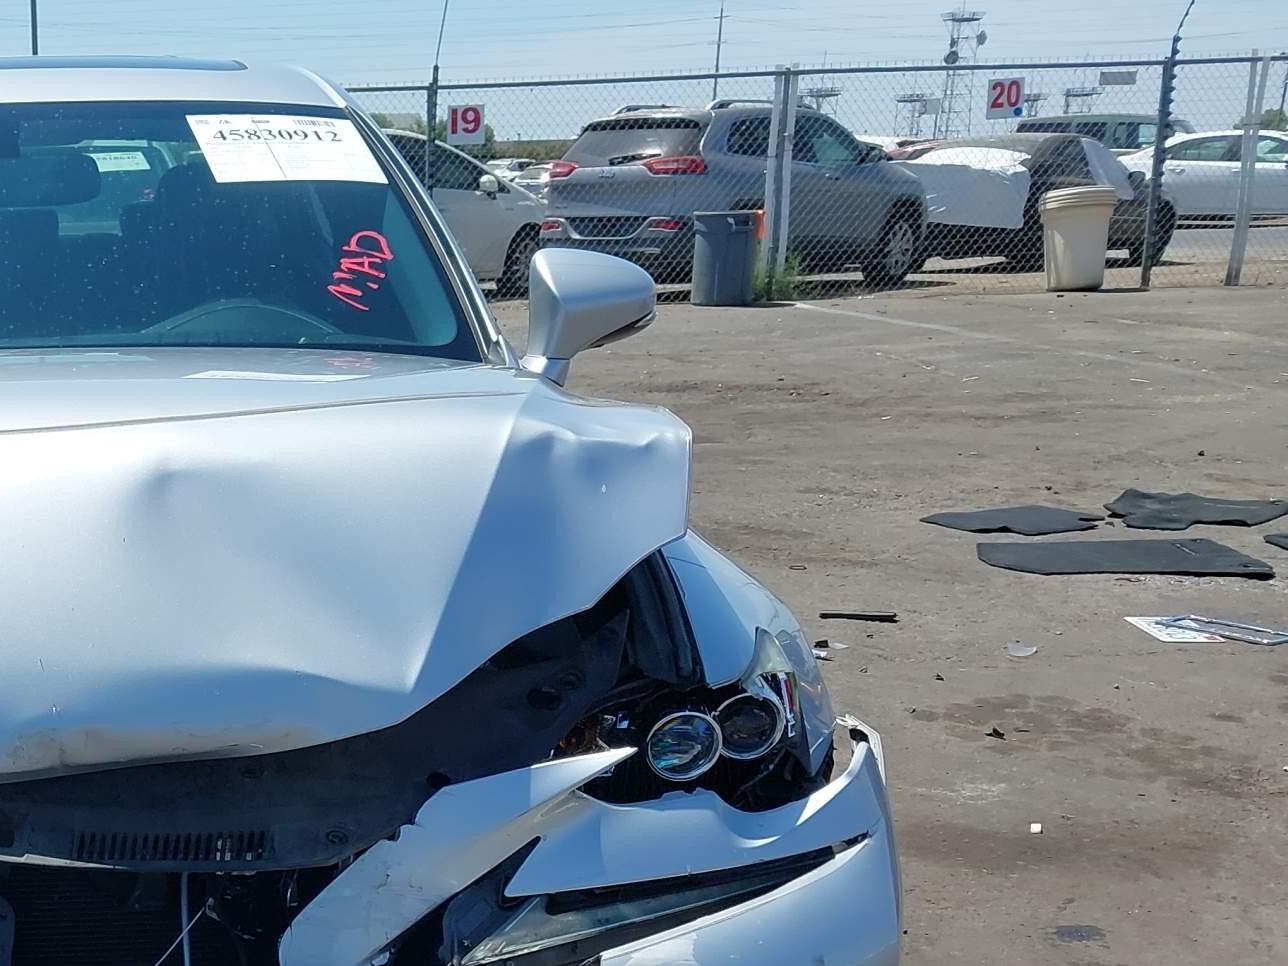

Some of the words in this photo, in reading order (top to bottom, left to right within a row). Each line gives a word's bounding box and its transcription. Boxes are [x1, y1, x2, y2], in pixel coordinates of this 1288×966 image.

[991, 81, 1021, 109] 20
[212, 128, 343, 142] 45830912
[451, 107, 481, 135] 19
